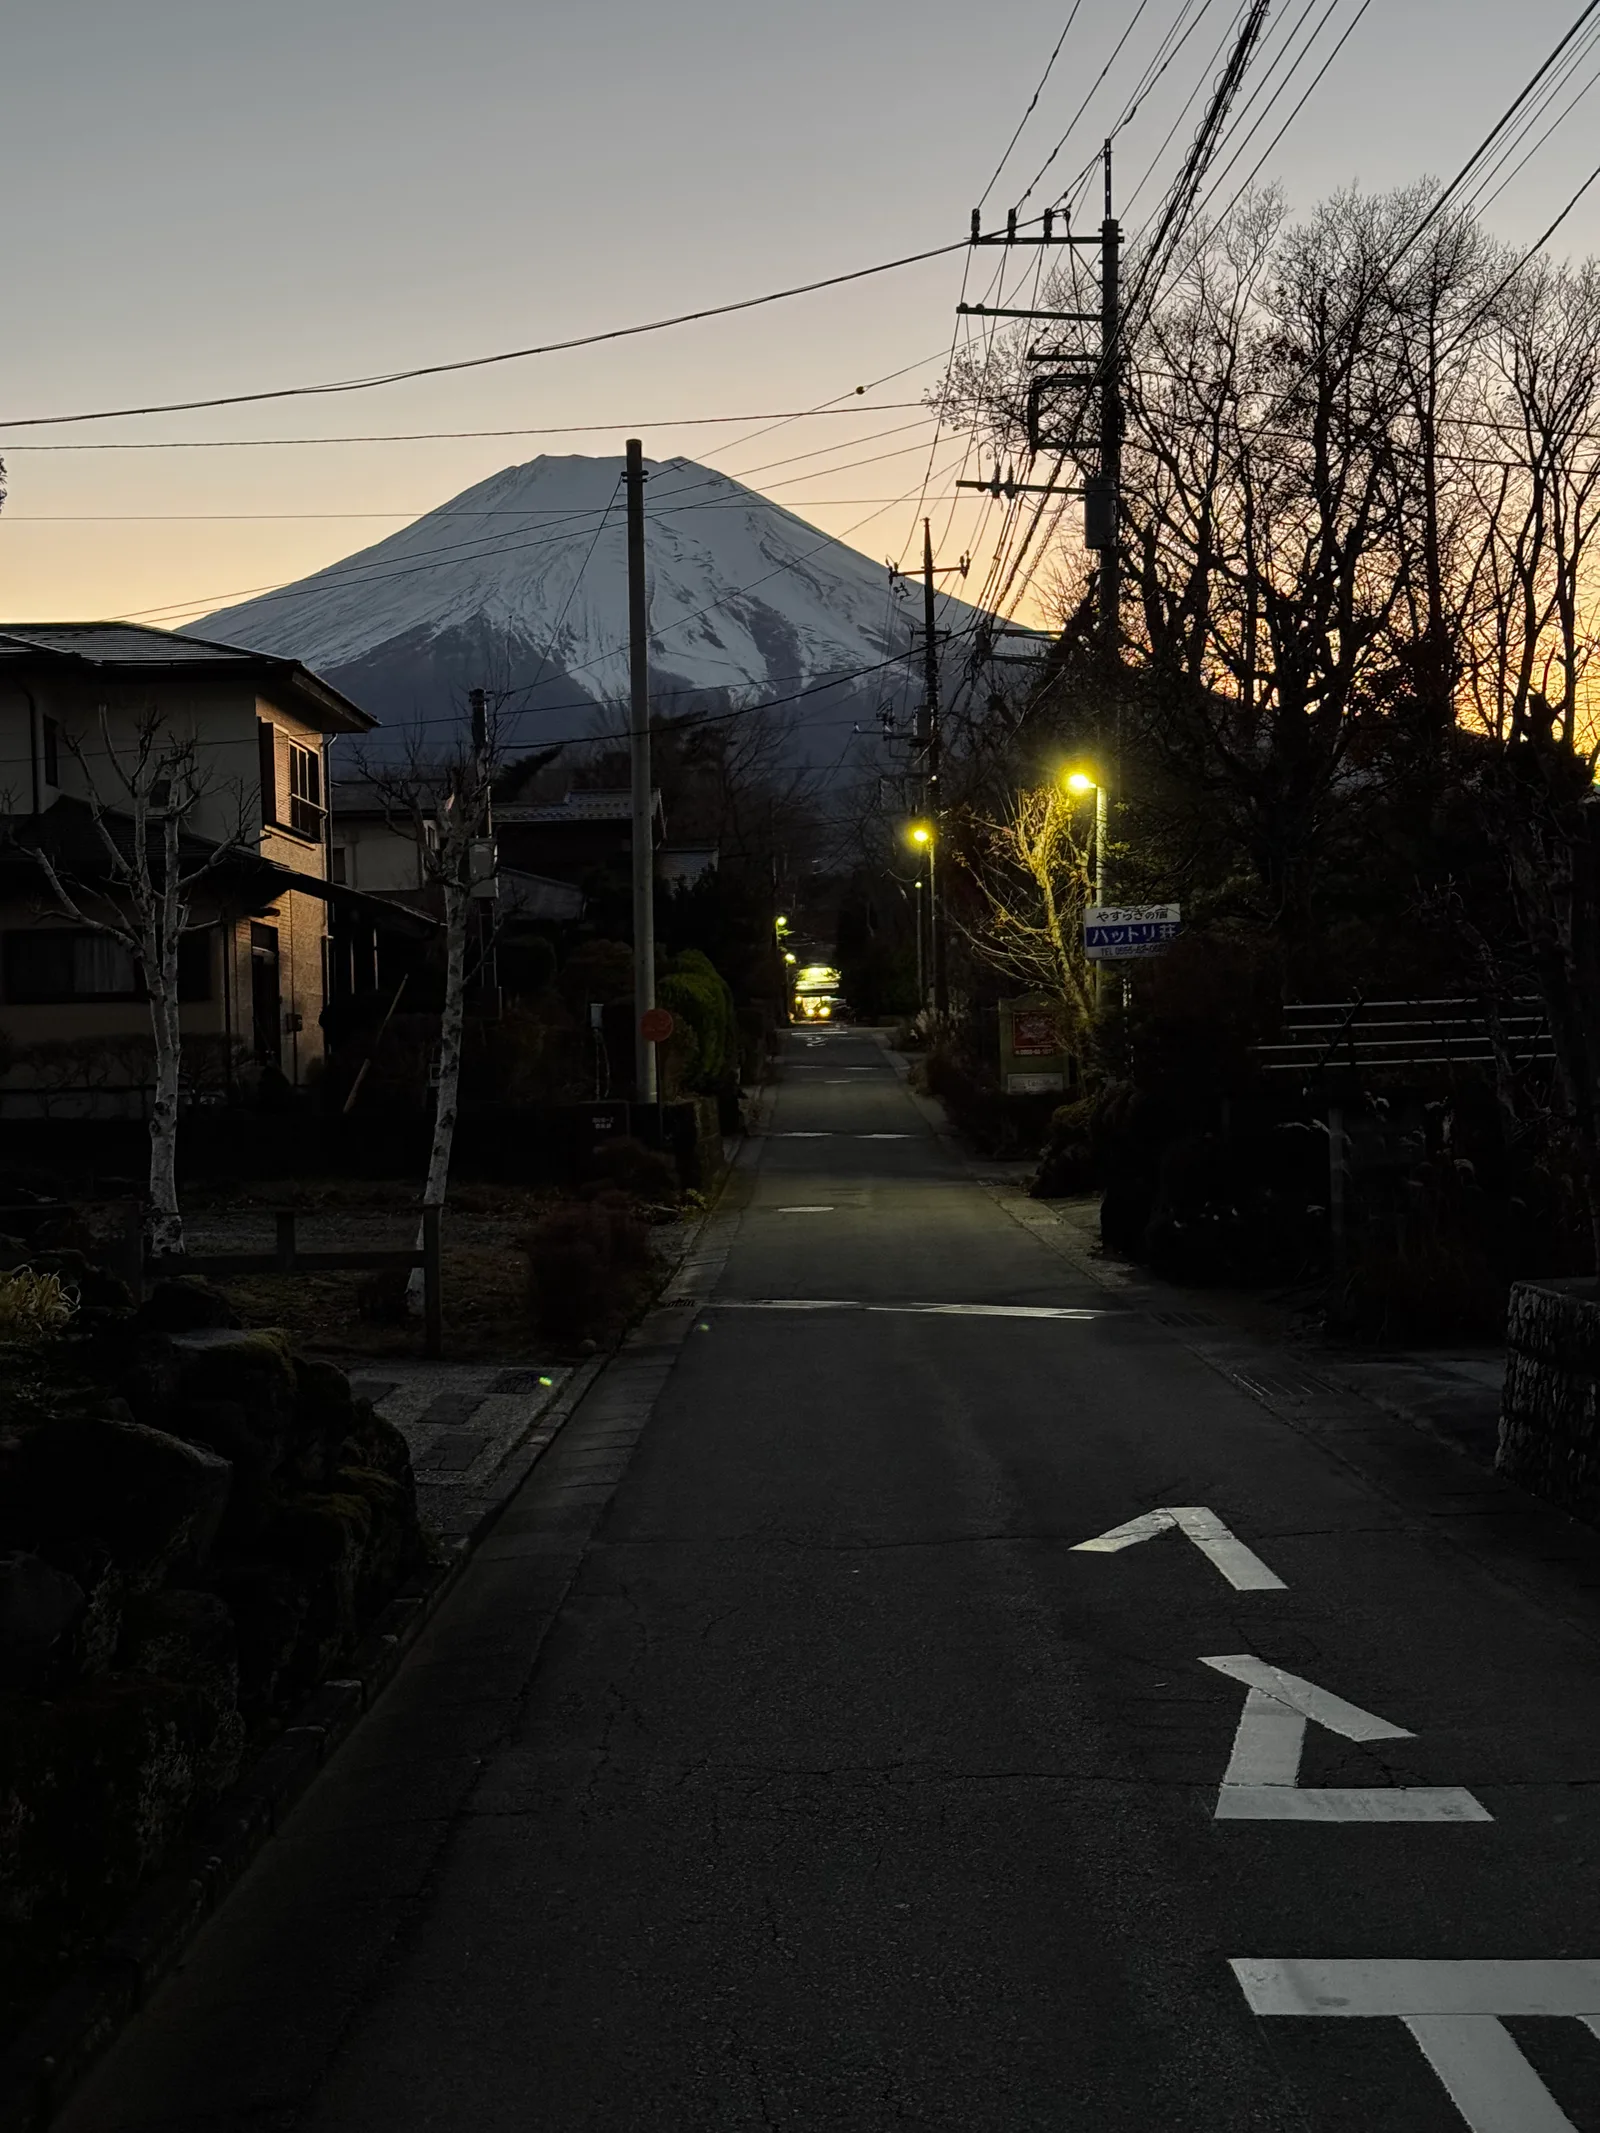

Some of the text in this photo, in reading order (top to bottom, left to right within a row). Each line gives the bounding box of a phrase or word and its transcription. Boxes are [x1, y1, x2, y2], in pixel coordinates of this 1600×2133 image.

[1092, 924, 1176, 944] ハットリ荘
[1101, 947, 1113, 957] TEL
